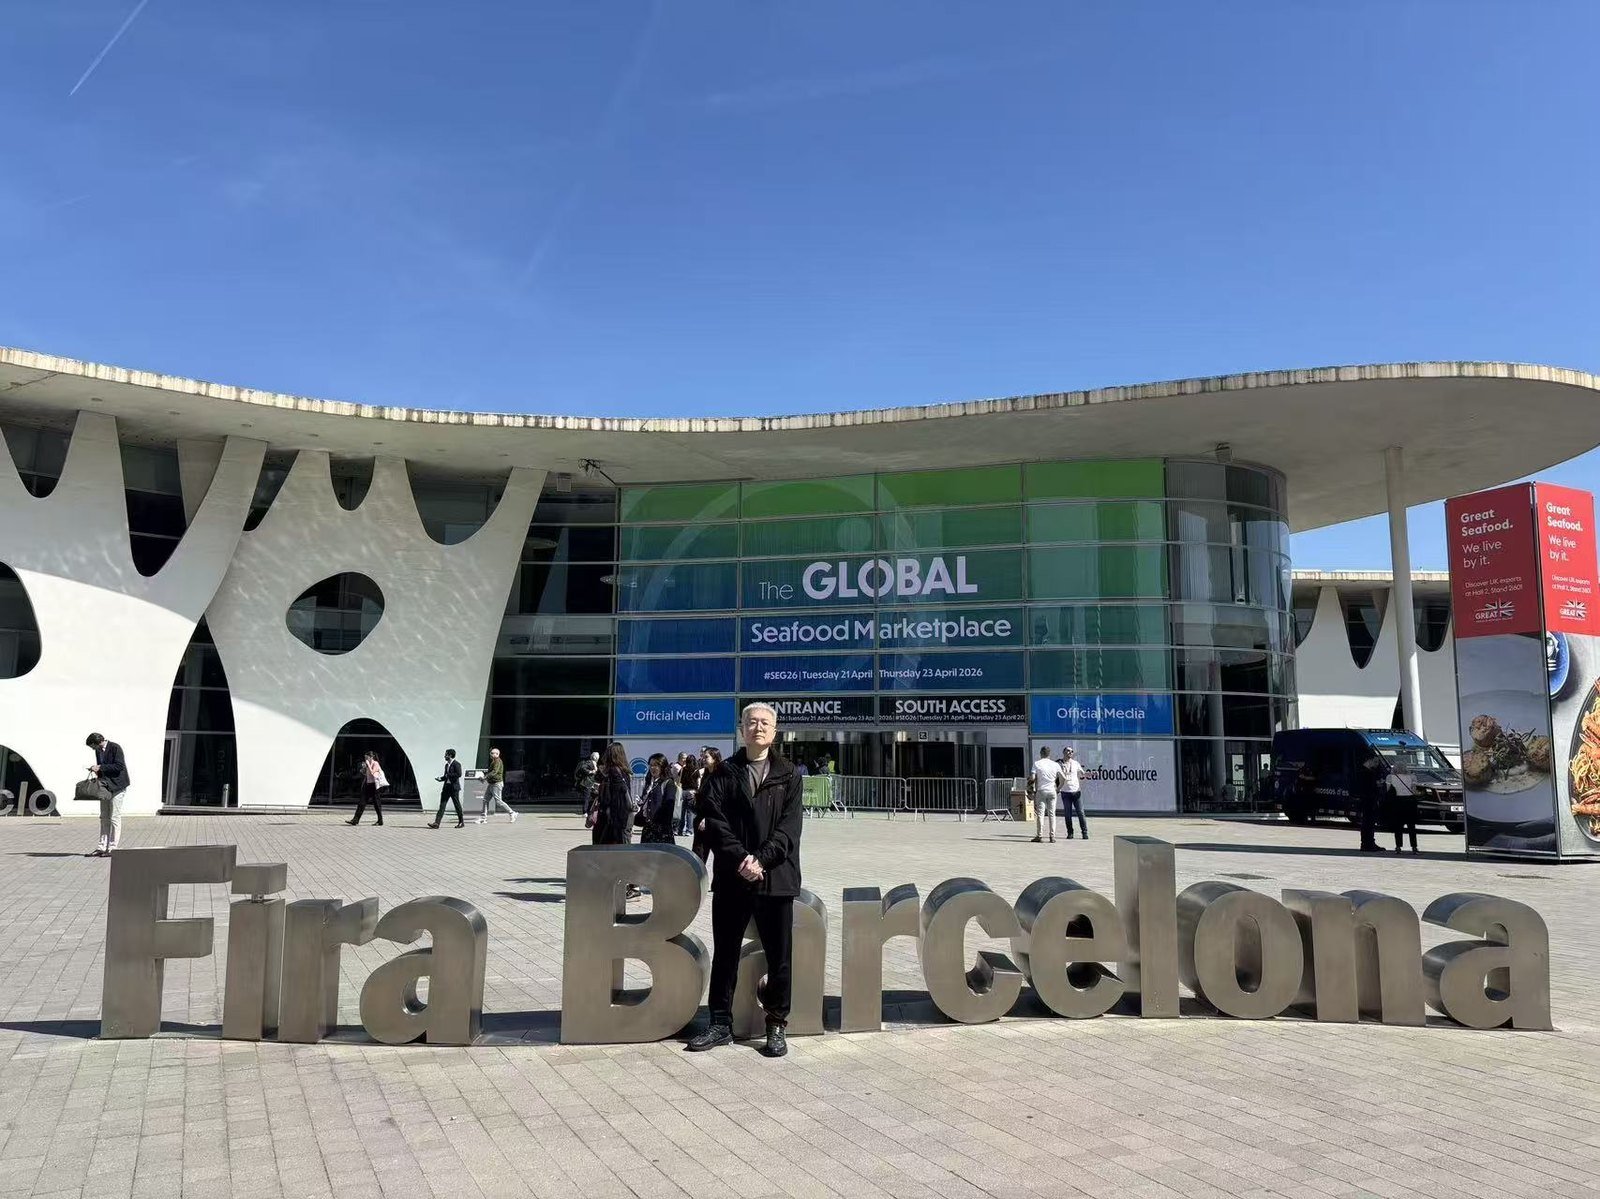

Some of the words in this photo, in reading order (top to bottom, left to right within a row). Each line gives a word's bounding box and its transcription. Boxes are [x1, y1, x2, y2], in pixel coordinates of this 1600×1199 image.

[1461, 509, 1495, 523] Great
[1546, 502, 1571, 516] Great
[1462, 519, 1513, 537] Seafood.
[1547, 515, 1584, 532] Seafood.
[1462, 543, 1480, 553] We
[1482, 540, 1502, 551] live
[1548, 534, 1562, 546] We
[1562, 536, 1577, 549] live
[1463, 557, 1477, 569] by
[1479, 555, 1490, 566] it.
[1550, 548, 1560, 562] by
[759, 581, 794, 600] The
[802, 556, 978, 600] GLOBAL
[1475, 610, 1498, 620] GREAT
[751, 620, 849, 643] Seafood
[854, 616, 1012, 643] Marketplace
[763, 671, 798, 681] #SEG26
[802, 670, 839, 681] Tuesday
[841, 671, 850, 679] 21
[850, 669, 873, 680] April
[878, 668, 921, 680] Thursday
[922, 669, 933, 678] 23
[934, 668, 958, 679] April
[959, 667, 984, 678] 2026
[895, 699, 947, 714] SOUTH
[949, 699, 1006, 713] ACCESS
[1056, 708, 1100, 719] Official
[1104, 707, 1146, 719] Media
[636, 710, 674, 721] Official
[676, 710, 711, 721] Media
[99, 844, 488, 1046] Fira
